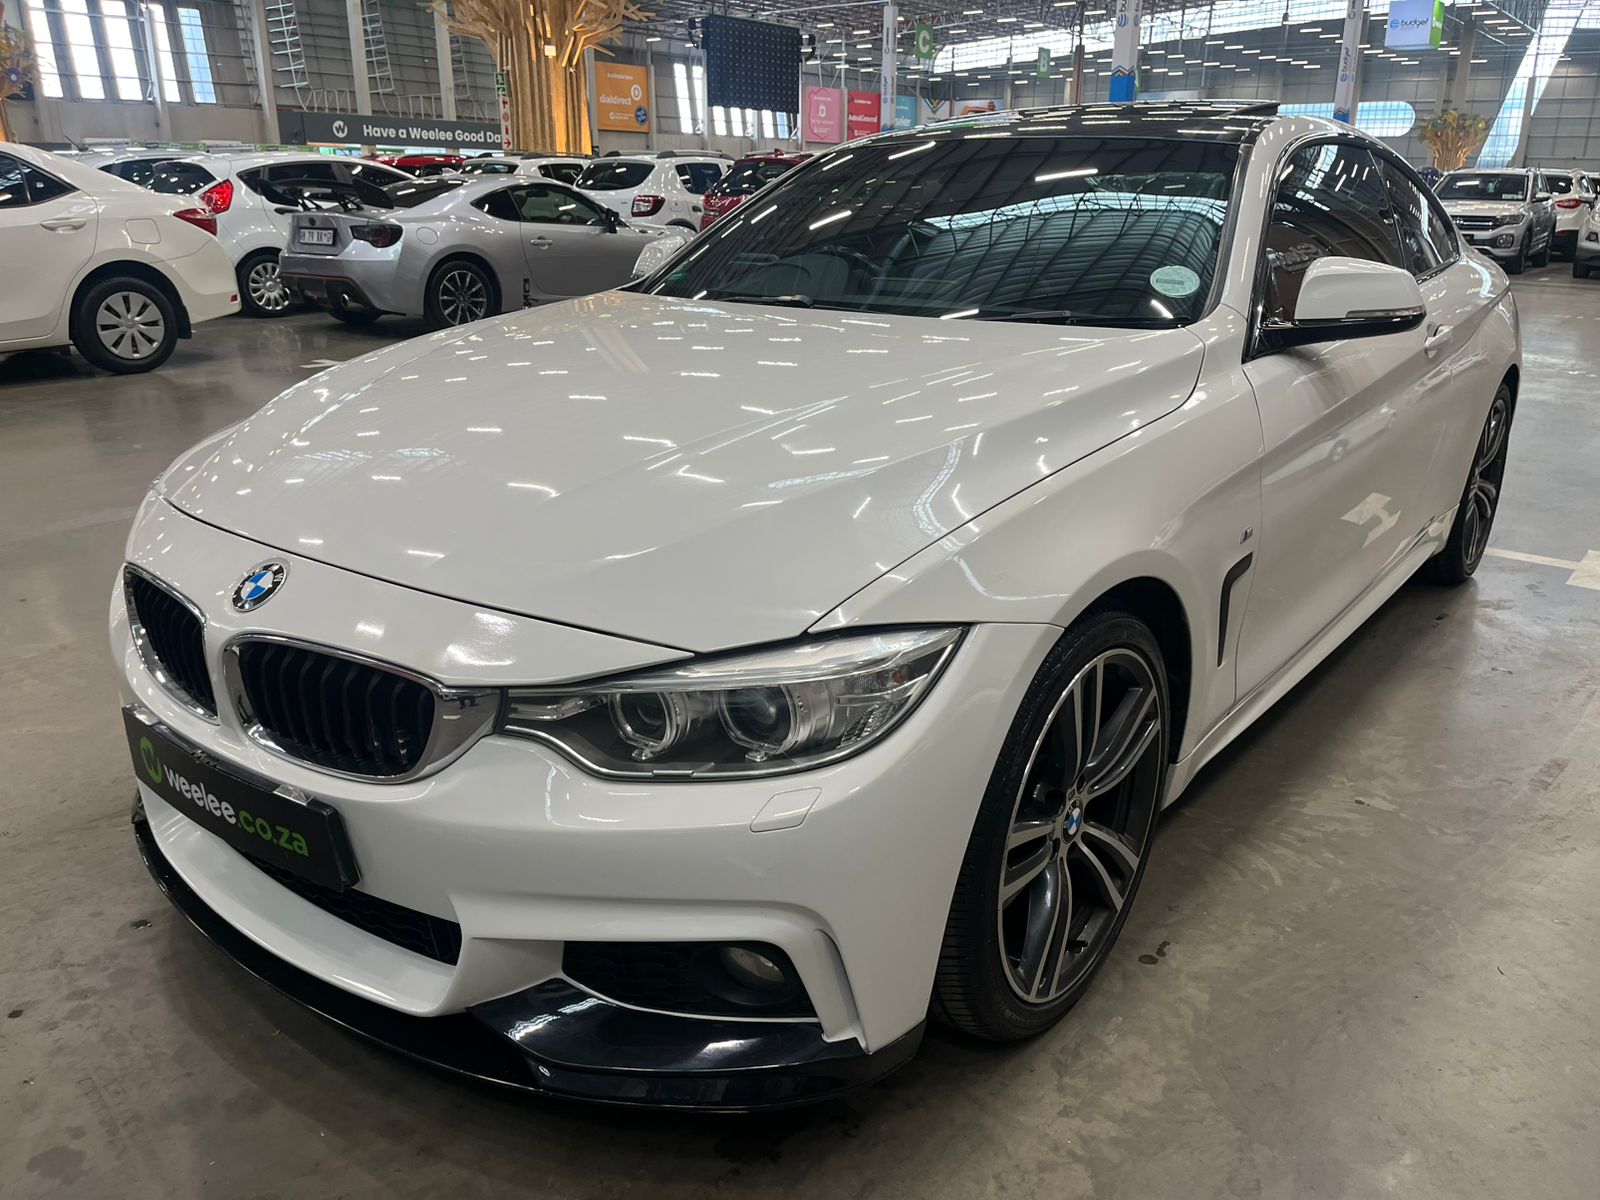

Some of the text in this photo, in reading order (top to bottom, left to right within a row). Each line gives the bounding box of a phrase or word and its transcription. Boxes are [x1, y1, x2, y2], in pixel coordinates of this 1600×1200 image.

[1401, 17, 1429, 29] budget
[919, 30, 931, 54] C
[1039, 51, 1048, 73] B
[600, 95, 632, 105] dialdirect
[363, 124, 501, 143] Have a Weelee Good Da
[163, 764, 309, 857] weelee.co.za
